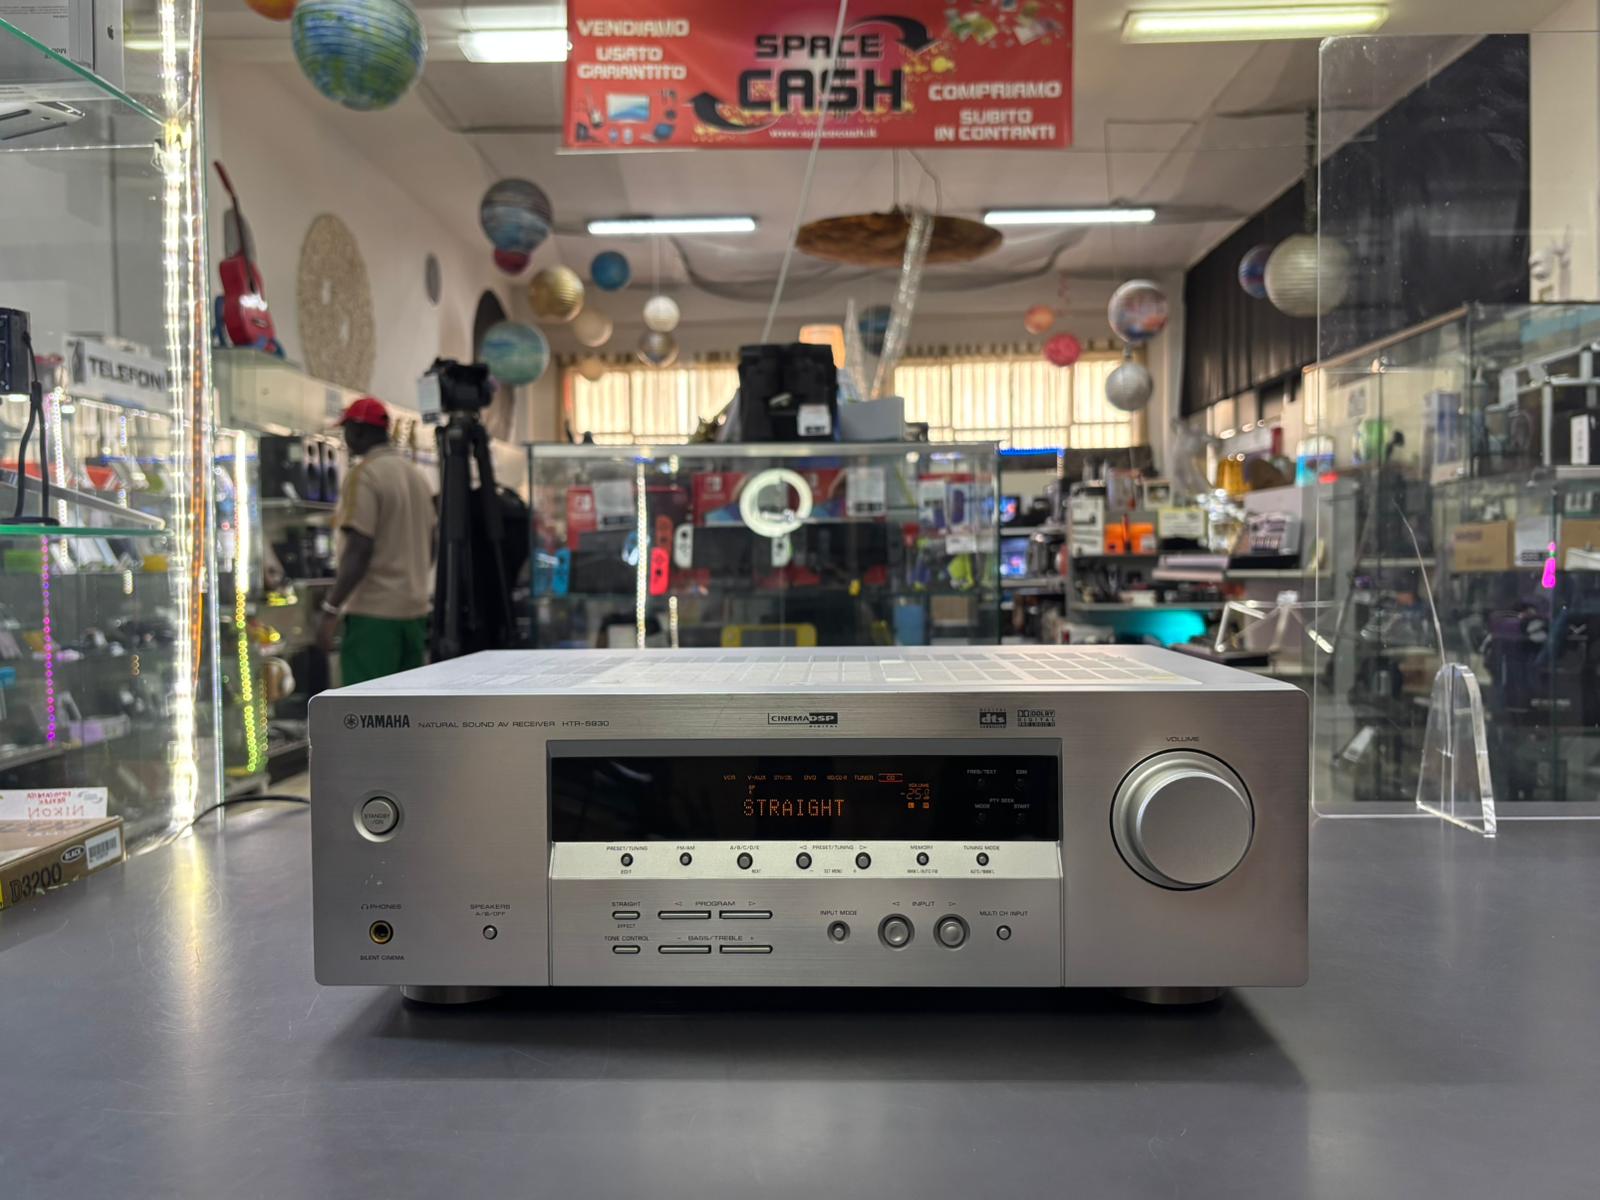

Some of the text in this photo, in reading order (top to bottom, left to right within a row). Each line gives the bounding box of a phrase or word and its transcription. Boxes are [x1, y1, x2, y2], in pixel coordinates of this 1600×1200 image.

[576, 19, 690, 37] VENDIAMO
[595, 47, 664, 62] USATO
[756, 34, 881, 58] SPACE
[576, 63, 688, 80] GARANTITO
[740, 69, 903, 112] CASH
[928, 80, 1063, 101] COMPRIAMO
[960, 107, 1033, 125] SUBITO
[934, 123, 1056, 142] IN CONTANTI
[360, 714, 410, 728] YAMAHA
[498, 720, 509, 728] AV
[981, 713, 1006, 723] dts
[743, 798, 845, 816] STRAIGHT
[10, 862, 62, 904] D3200
